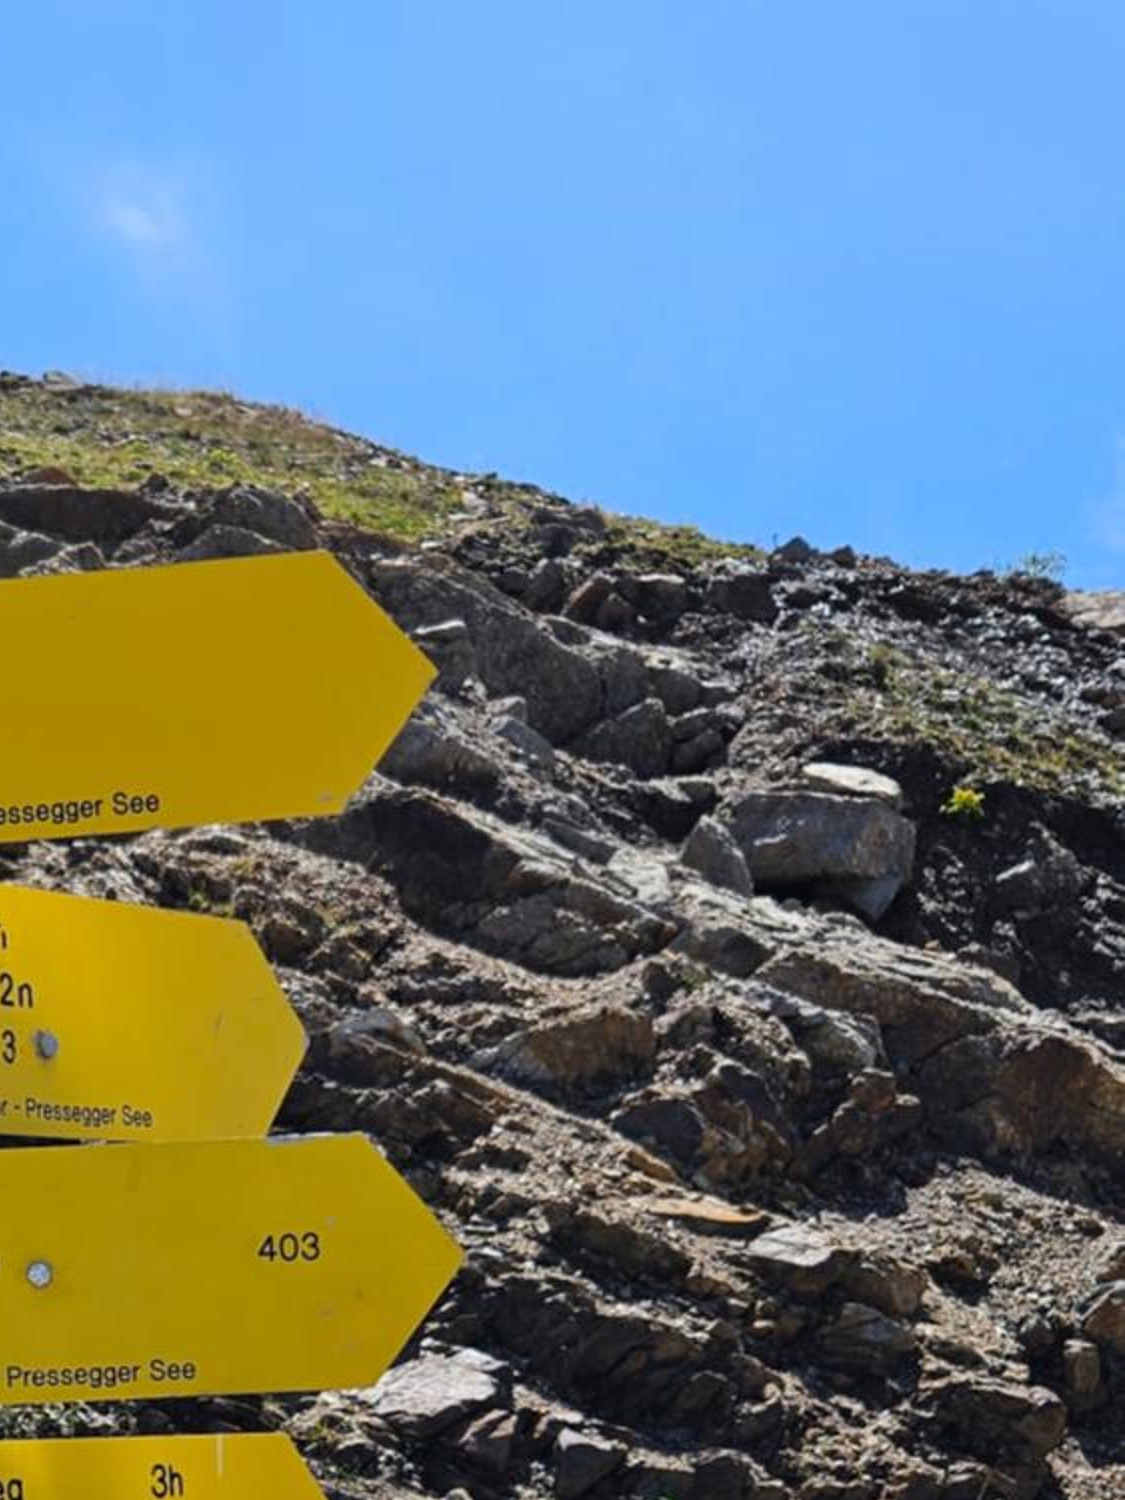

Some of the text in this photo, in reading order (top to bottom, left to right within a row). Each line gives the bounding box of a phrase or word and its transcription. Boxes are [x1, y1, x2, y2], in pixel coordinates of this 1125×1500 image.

[112, 791, 160, 816] See
[1, 1029, 17, 1065] 3
[25, 1097, 117, 1128] Pressegger
[122, 1104, 153, 1128] See
[257, 1231, 321, 1262] 403
[6, 1365, 141, 1389] Pressegger
[149, 1359, 196, 1382] See
[151, 1463, 184, 1499] 3h
